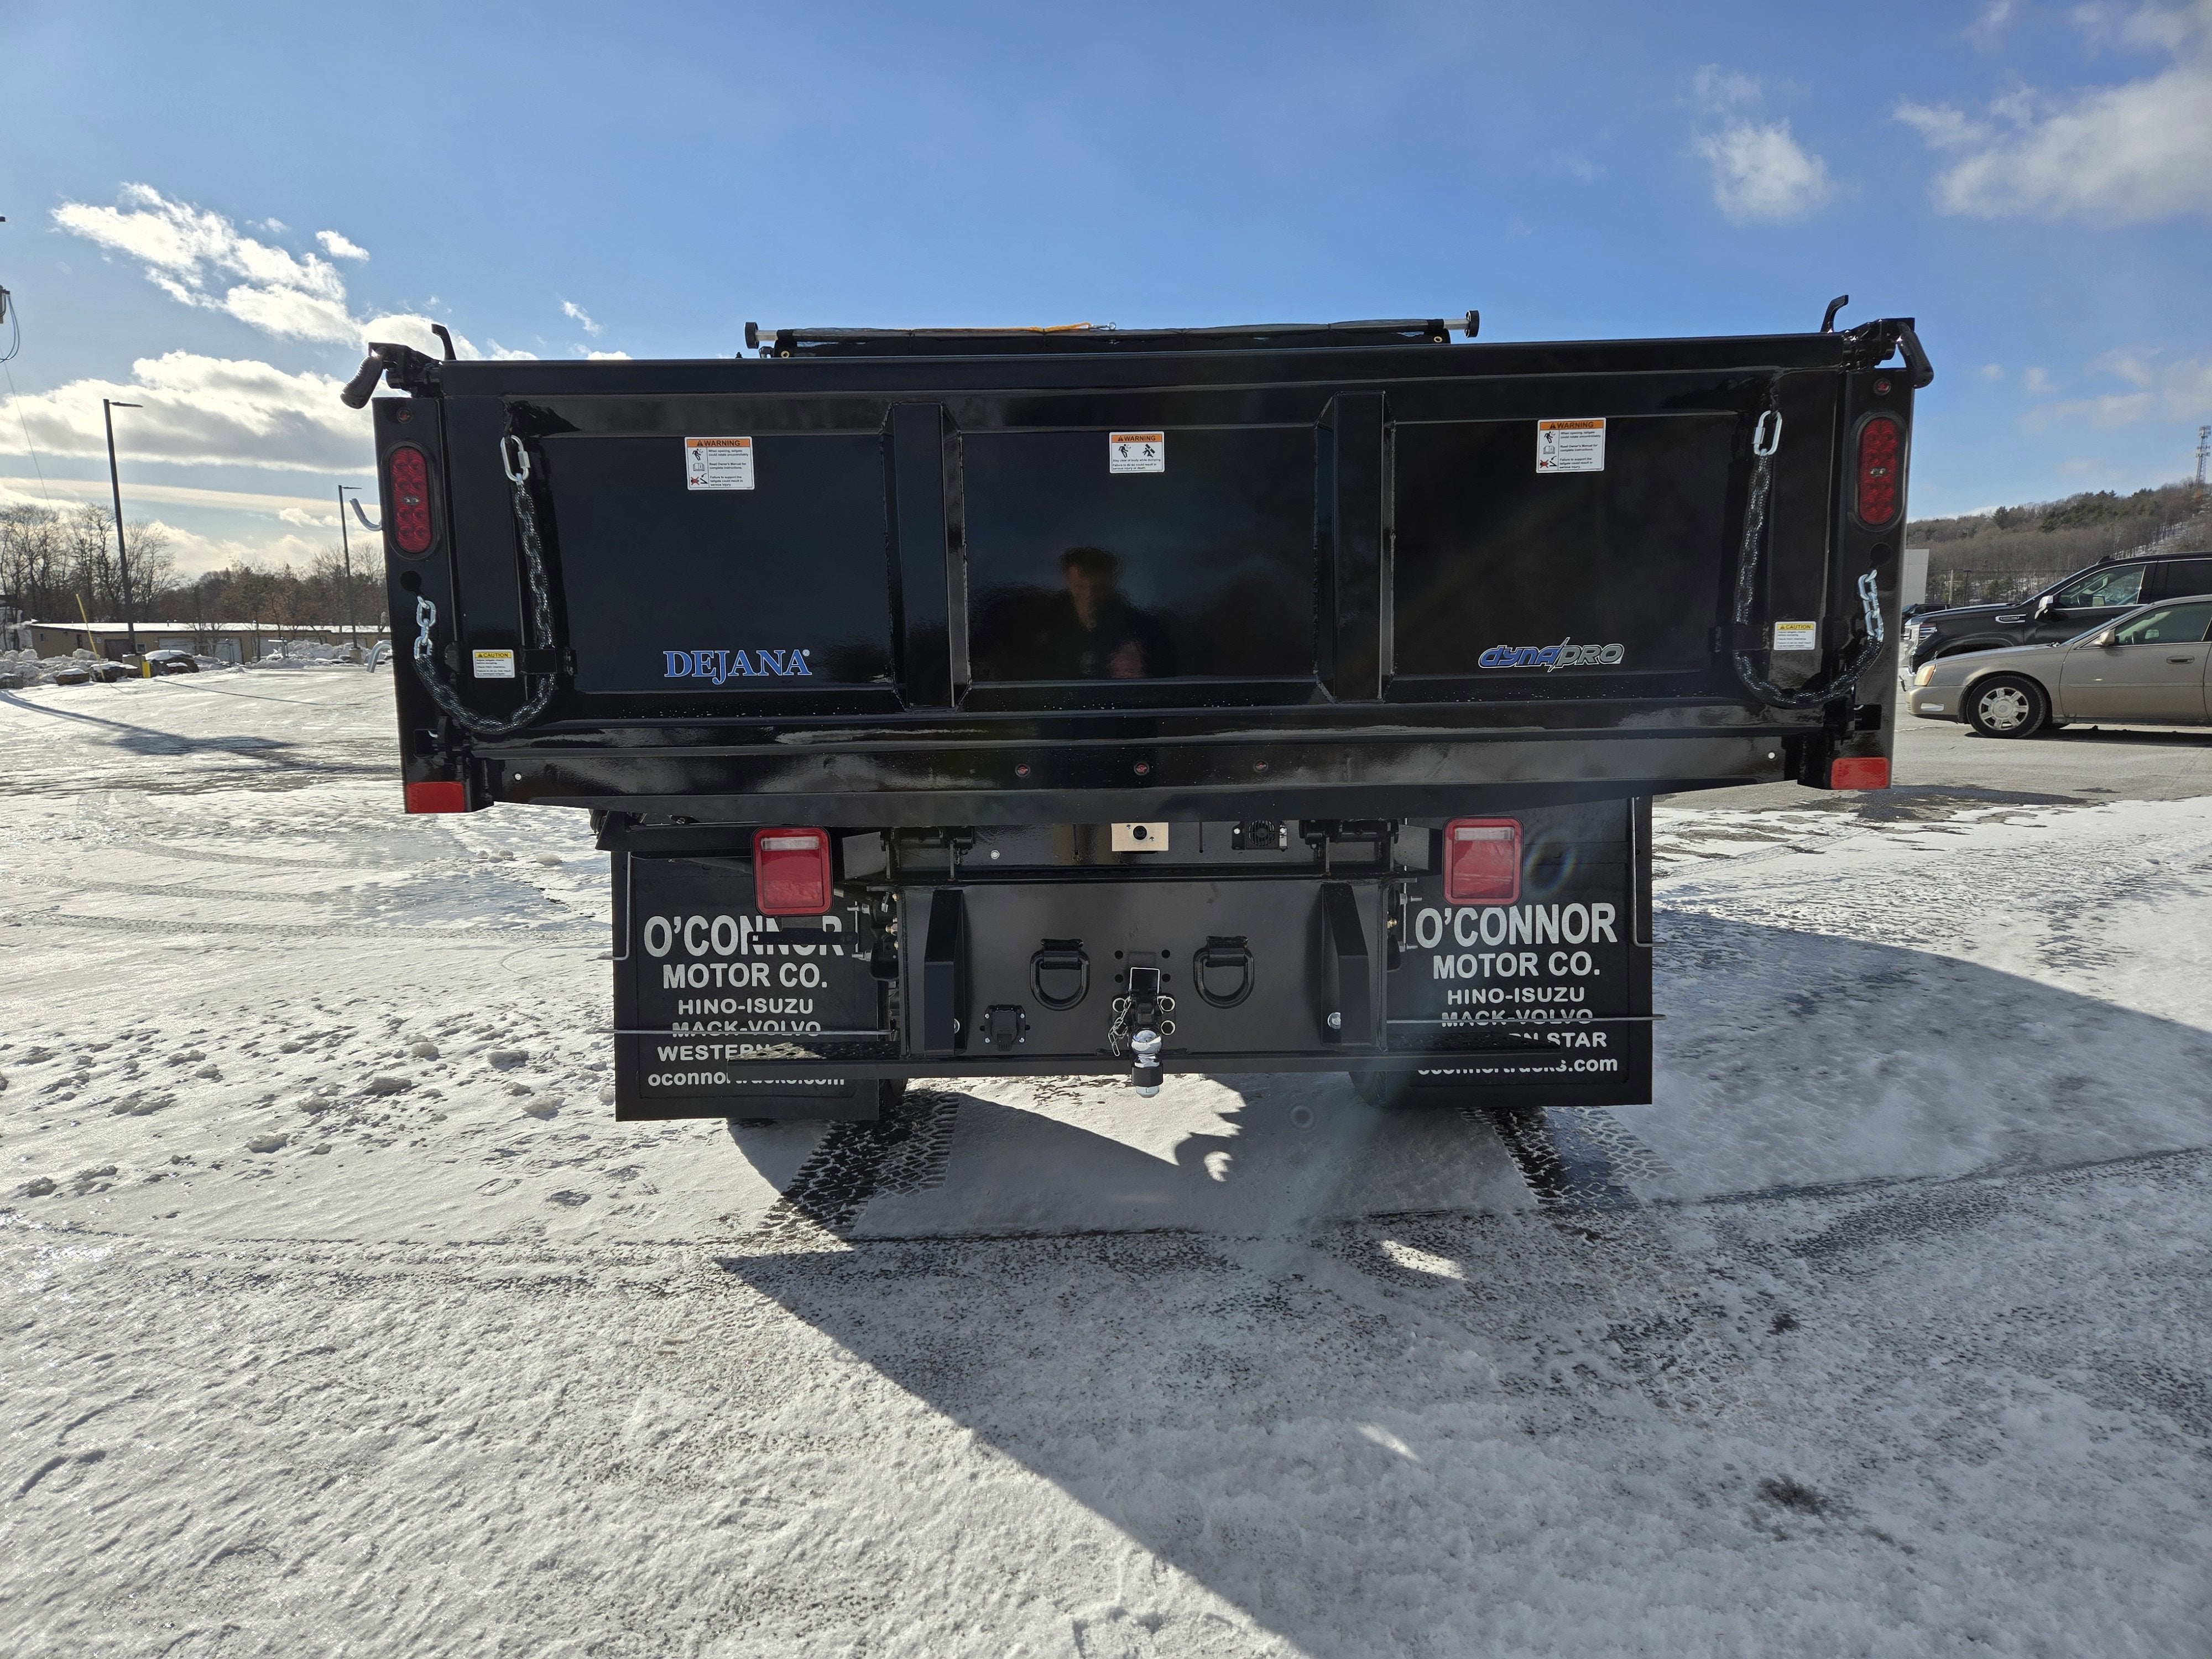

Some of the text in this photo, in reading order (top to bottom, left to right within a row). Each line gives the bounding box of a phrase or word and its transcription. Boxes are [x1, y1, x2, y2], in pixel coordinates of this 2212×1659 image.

[1415, 902, 1618, 949] O'CONNOR
[663, 963, 828, 989] MOTOR CO.
[1433, 951, 1600, 979] MOTOR CO.
[678, 998, 814, 1015] HINO-ISUZU
[1447, 987, 1585, 1005] HINO-ISUZU
